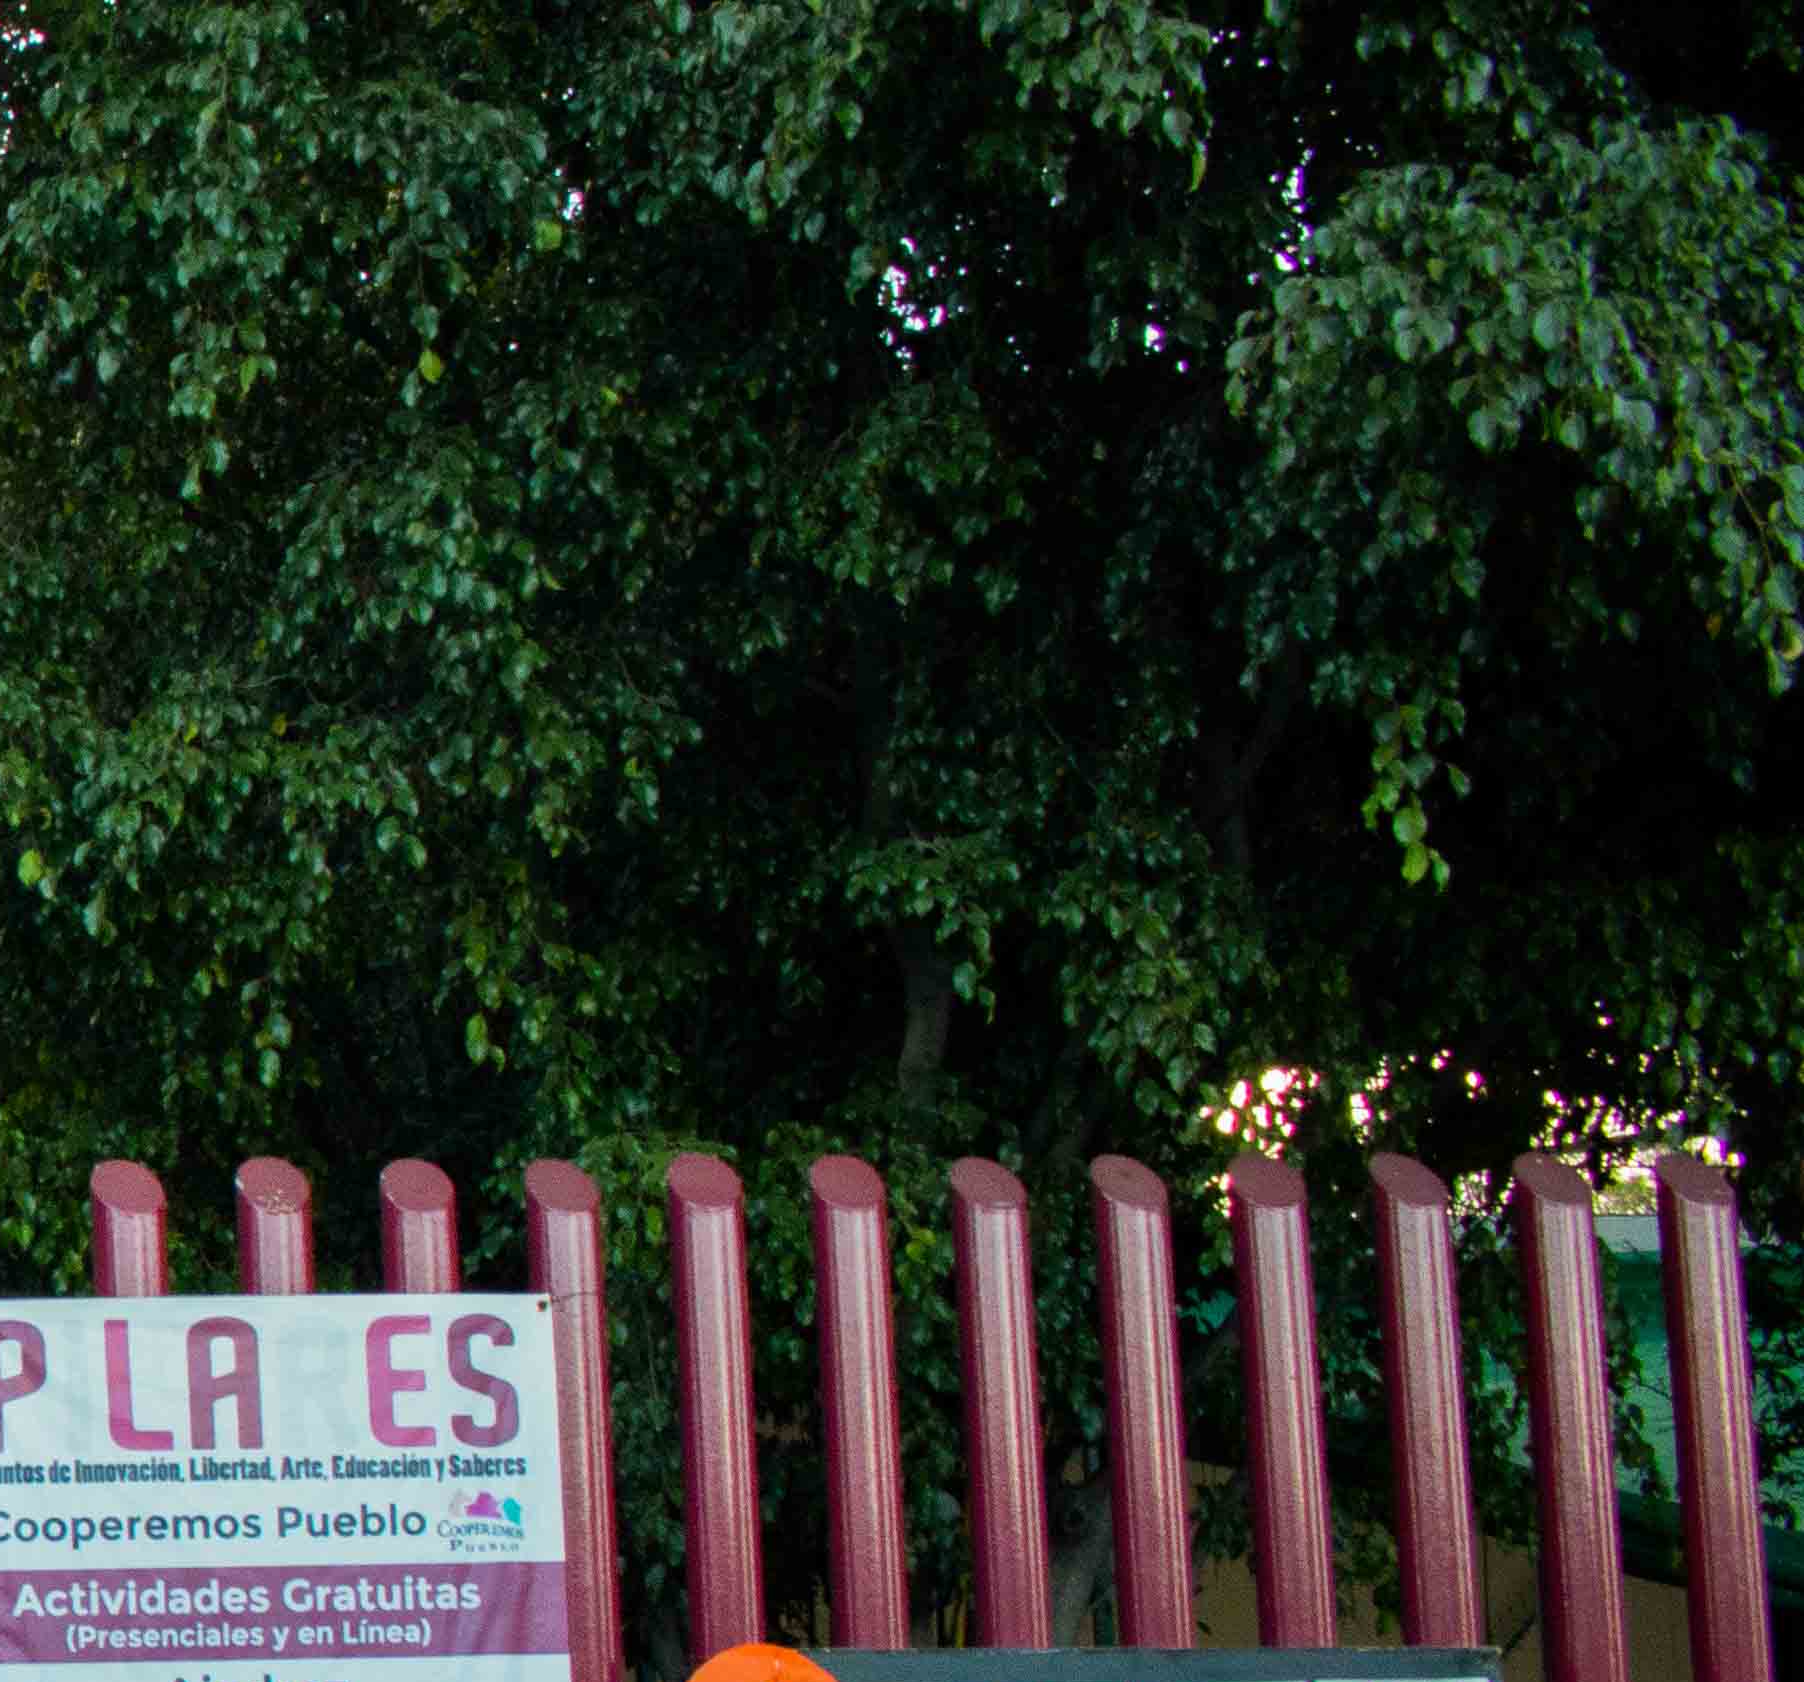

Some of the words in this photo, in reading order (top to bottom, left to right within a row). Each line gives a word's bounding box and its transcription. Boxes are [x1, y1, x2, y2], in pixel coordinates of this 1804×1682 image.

[48, 1460, 71, 1484] de
[74, 1457, 185, 1484] Innovación,
[188, 1456, 276, 1482] Libertad,
[280, 1455, 328, 1481] Arte,
[331, 1453, 431, 1480] Educación
[435, 1458, 445, 1482] y
[448, 1453, 526, 1478] Saberes
[277, 1503, 427, 1539] Pueblo
[12, 1578, 271, 1618] Actividades
[283, 1575, 482, 1613] Gratuitas
[66, 1621, 265, 1653] (Presenciales
[273, 1627, 287, 1652] y
[297, 1625, 334, 1645] en
[342, 1617, 433, 1647] Línea)
